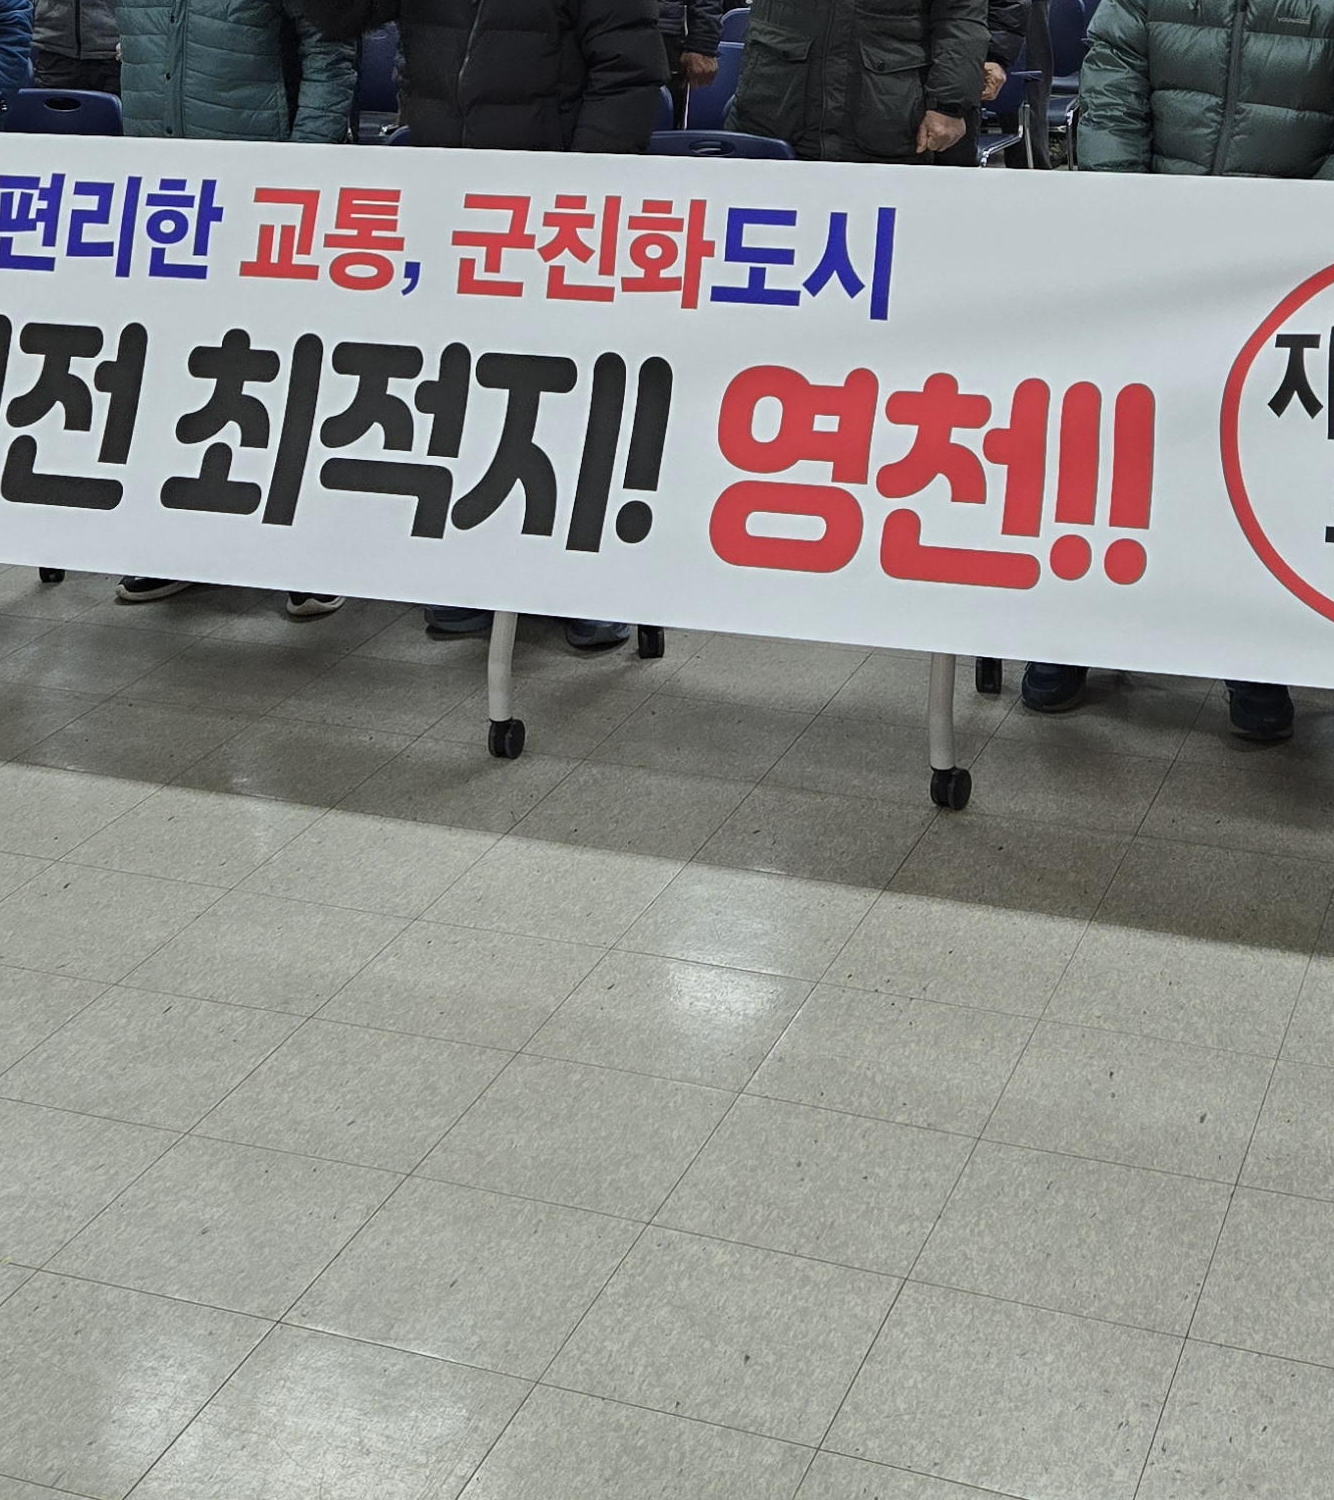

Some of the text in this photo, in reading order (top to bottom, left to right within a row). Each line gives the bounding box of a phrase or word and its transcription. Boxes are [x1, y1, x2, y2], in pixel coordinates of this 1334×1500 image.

[239, 187, 421, 296] 교통,
[451, 193, 896, 321] 군친화도시
[159, 328, 674, 553] 최적지!
[709, 365, 1156, 590] 영천!!
